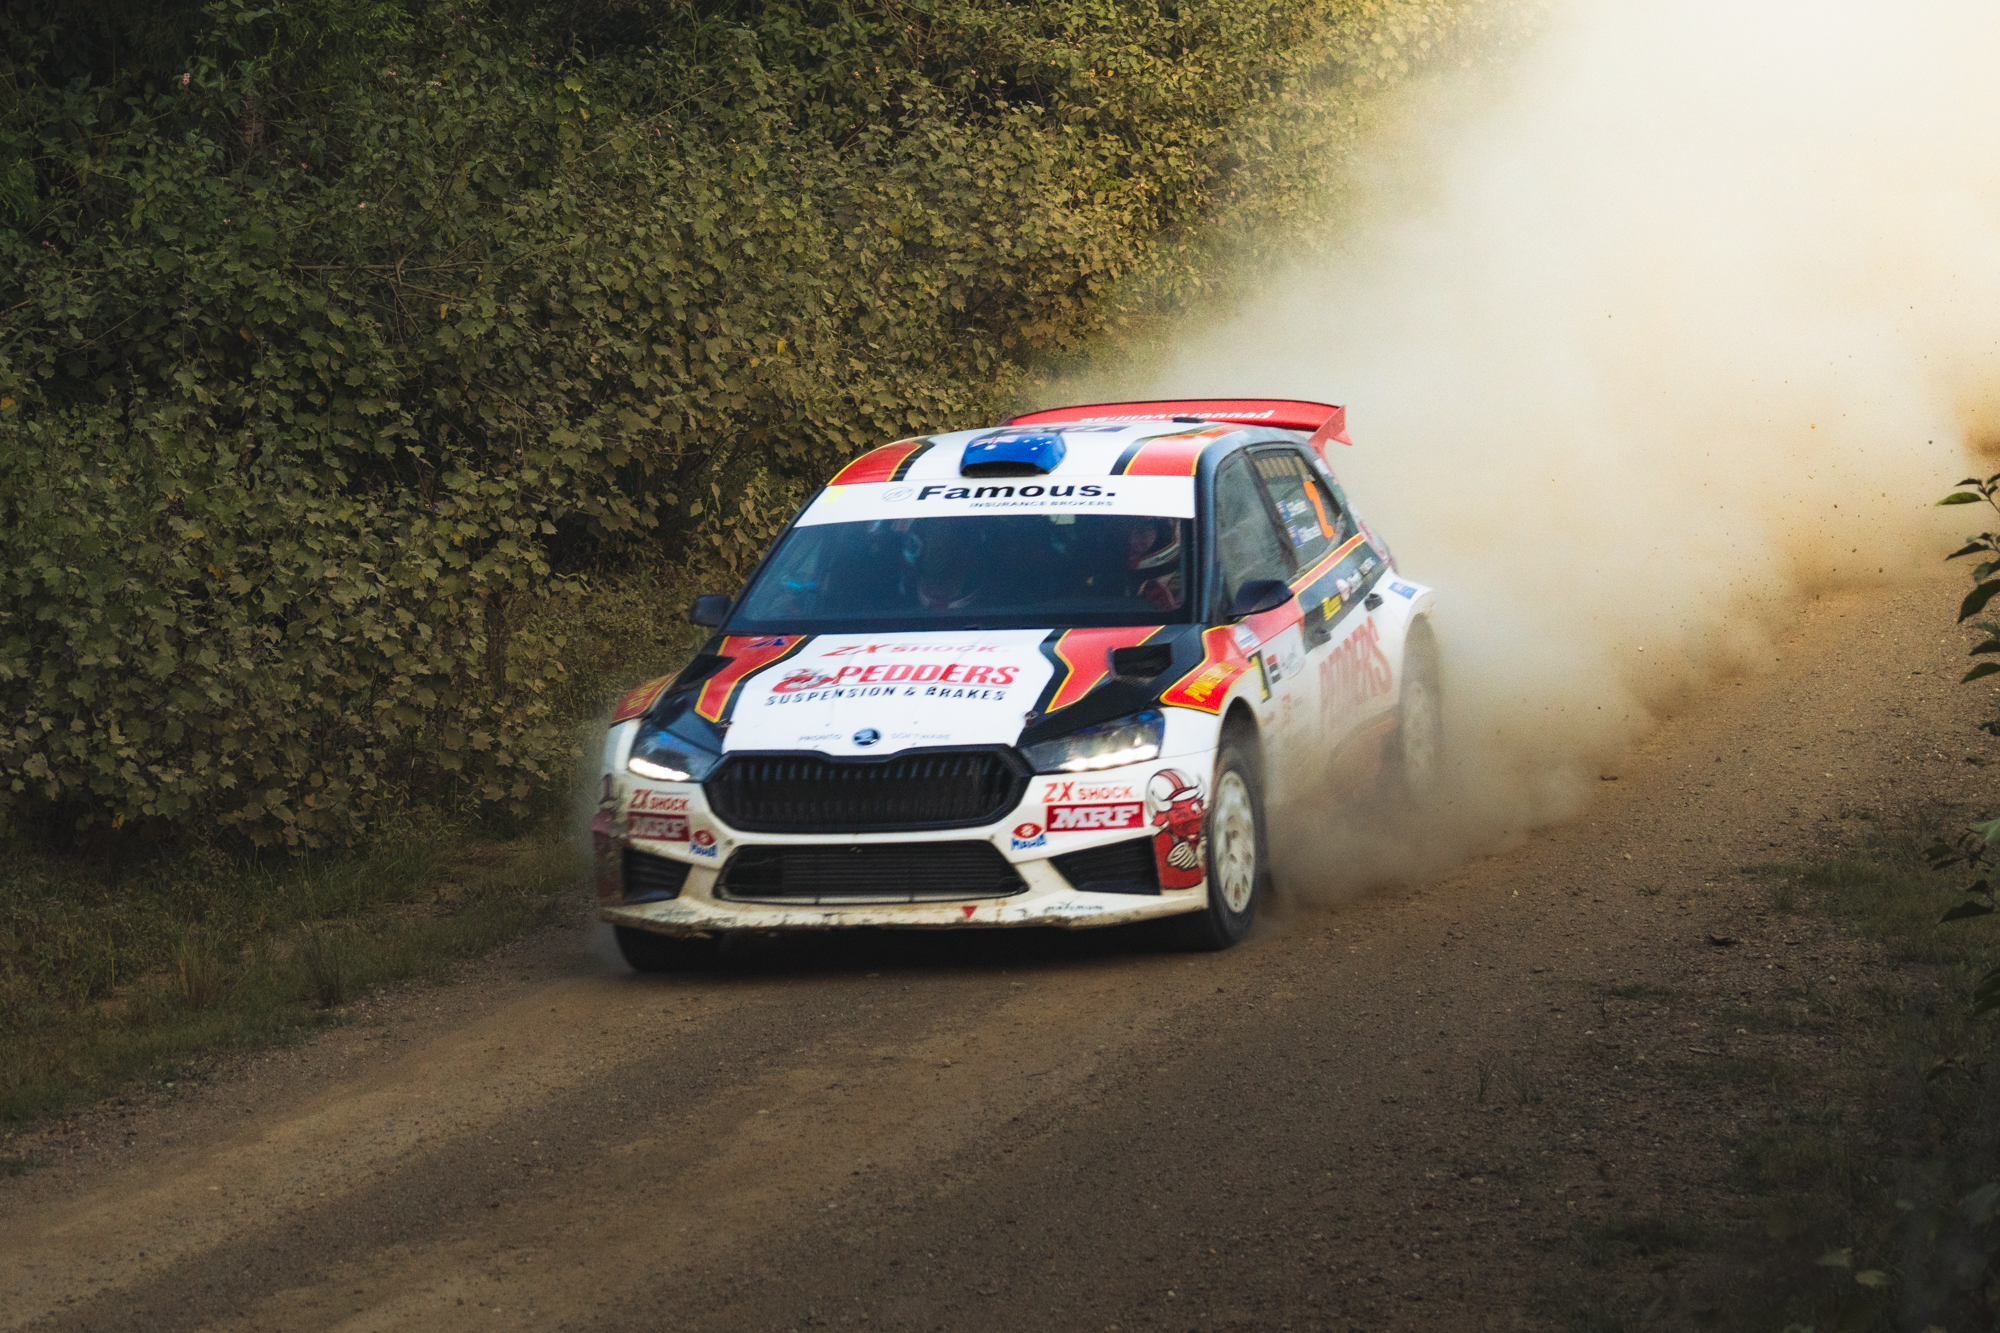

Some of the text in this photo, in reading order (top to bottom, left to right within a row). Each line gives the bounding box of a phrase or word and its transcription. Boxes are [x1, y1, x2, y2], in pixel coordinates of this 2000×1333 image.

[822, 486, 847, 503] 2
[917, 484, 1115, 502] Famous.
[969, 500, 1114, 508] INSURANCE BROKERS
[821, 645, 998, 658] ZX SHOCK
[833, 664, 1018, 686] PEDDERS
[764, 684, 1008, 706] SUSPENSION & BRAKES
[1043, 781, 1132, 803] ZX SHOCK
[1051, 805, 1140, 829] MRF
